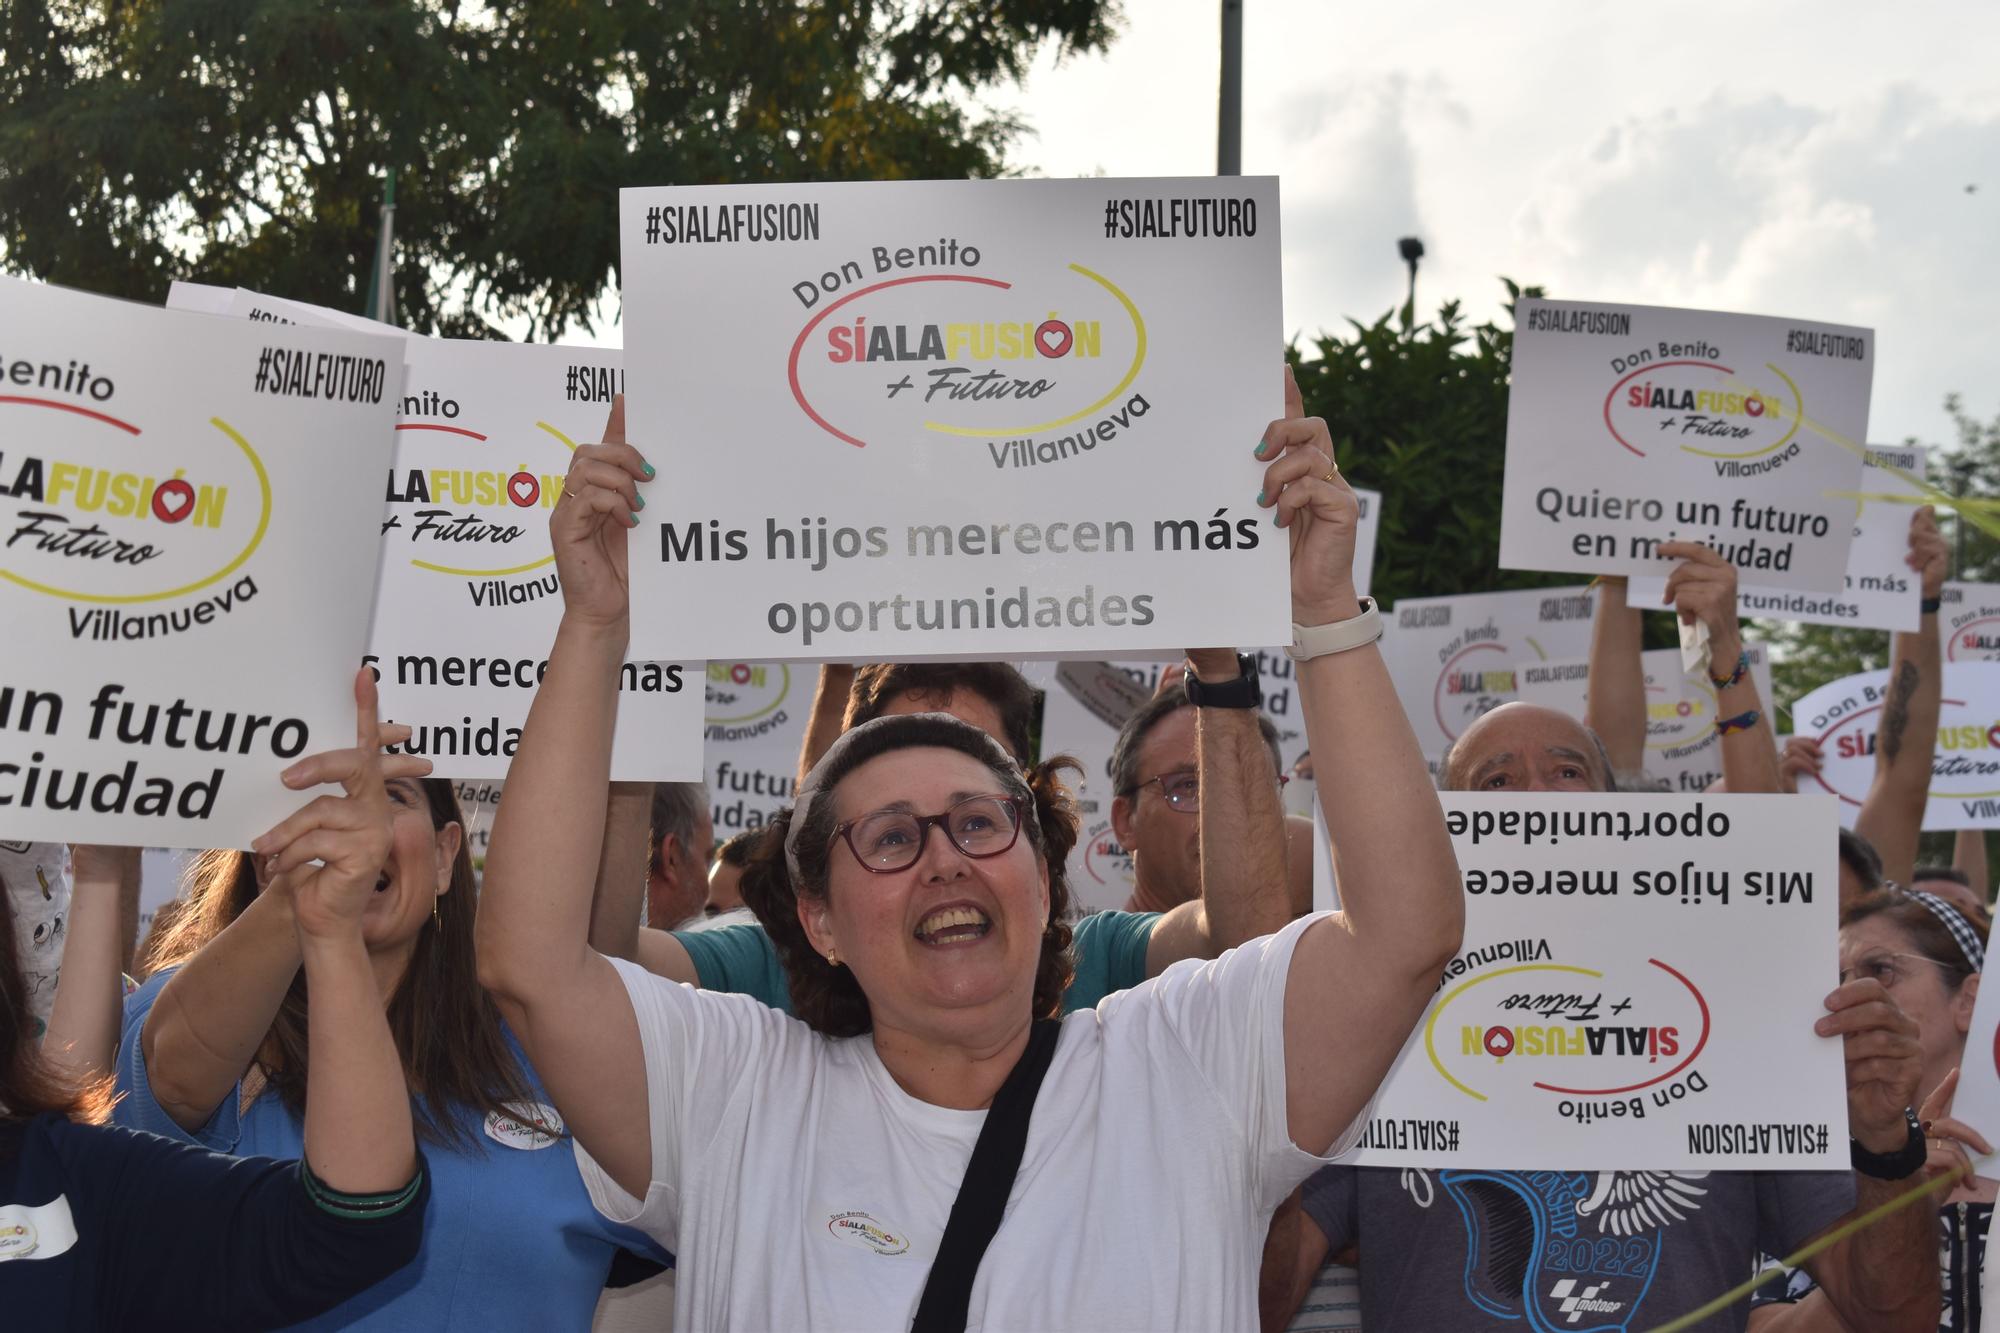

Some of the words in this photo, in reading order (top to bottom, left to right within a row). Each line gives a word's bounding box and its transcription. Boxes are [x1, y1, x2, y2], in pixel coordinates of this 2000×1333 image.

[646, 203, 820, 244] #SIALAFUSION
[1104, 198, 1257, 239] #SIALFUTURO
[793, 258, 863, 310] Don
[872, 237, 981, 273] Benito
[1528, 308, 1630, 336] #SIALAFUSION
[1611, 346, 1652, 375] Don
[1658, 340, 1720, 361] Benito
[1786, 328, 1864, 361] #SIALFUTURO
[0, 356, 115, 402] enito
[255, 346, 386, 405] #SIALFUTURO
[924, 367, 1057, 403] Futuro
[397, 391, 460, 418] nito
[988, 391, 1151, 469] Villanueva
[1681, 414, 1753, 440] Futuro
[1715, 441, 1800, 478] Villanueva
[411, 509, 526, 544] Futuro
[1535, 486, 1663, 524] Quiero
[1675, 500, 1720, 526] un
[1732, 498, 1829, 537] futuro
[6, 510, 164, 565] Futuro
[660, 519, 749, 563] Mis
[766, 516, 889, 572] hijos
[907, 516, 1134, 556] merecen
[1153, 507, 1260, 552] más
[1572, 531, 1616, 558] en
[1694, 534, 1793, 572] iudad
[468, 574, 561, 608] Villanu
[1859, 573, 1908, 594] más
[68, 574, 260, 641] Villanueva
[767, 584, 1155, 645] oportunidades
[1738, 592, 1860, 619] tunidades
[87, 683, 310, 759] futuro
[1811, 697, 1858, 729] Don
[716, 760, 796, 799] futu
[1460, 869, 1618, 896] merece
[1632, 861, 1730, 905] hijos
[1743, 872, 1814, 905] Mis
[1436, 938, 1552, 991] Villanuev
[1497, 992, 1602, 1022] Futuro
[1654, 1069, 1709, 1109] Don
[1557, 1099, 1645, 1125] Benito
[1355, 1118, 1460, 1152] #SIALFUTU
[1688, 1123, 1829, 1155] #SIALAFUSION
[1544, 1236, 1652, 1279] 2022
